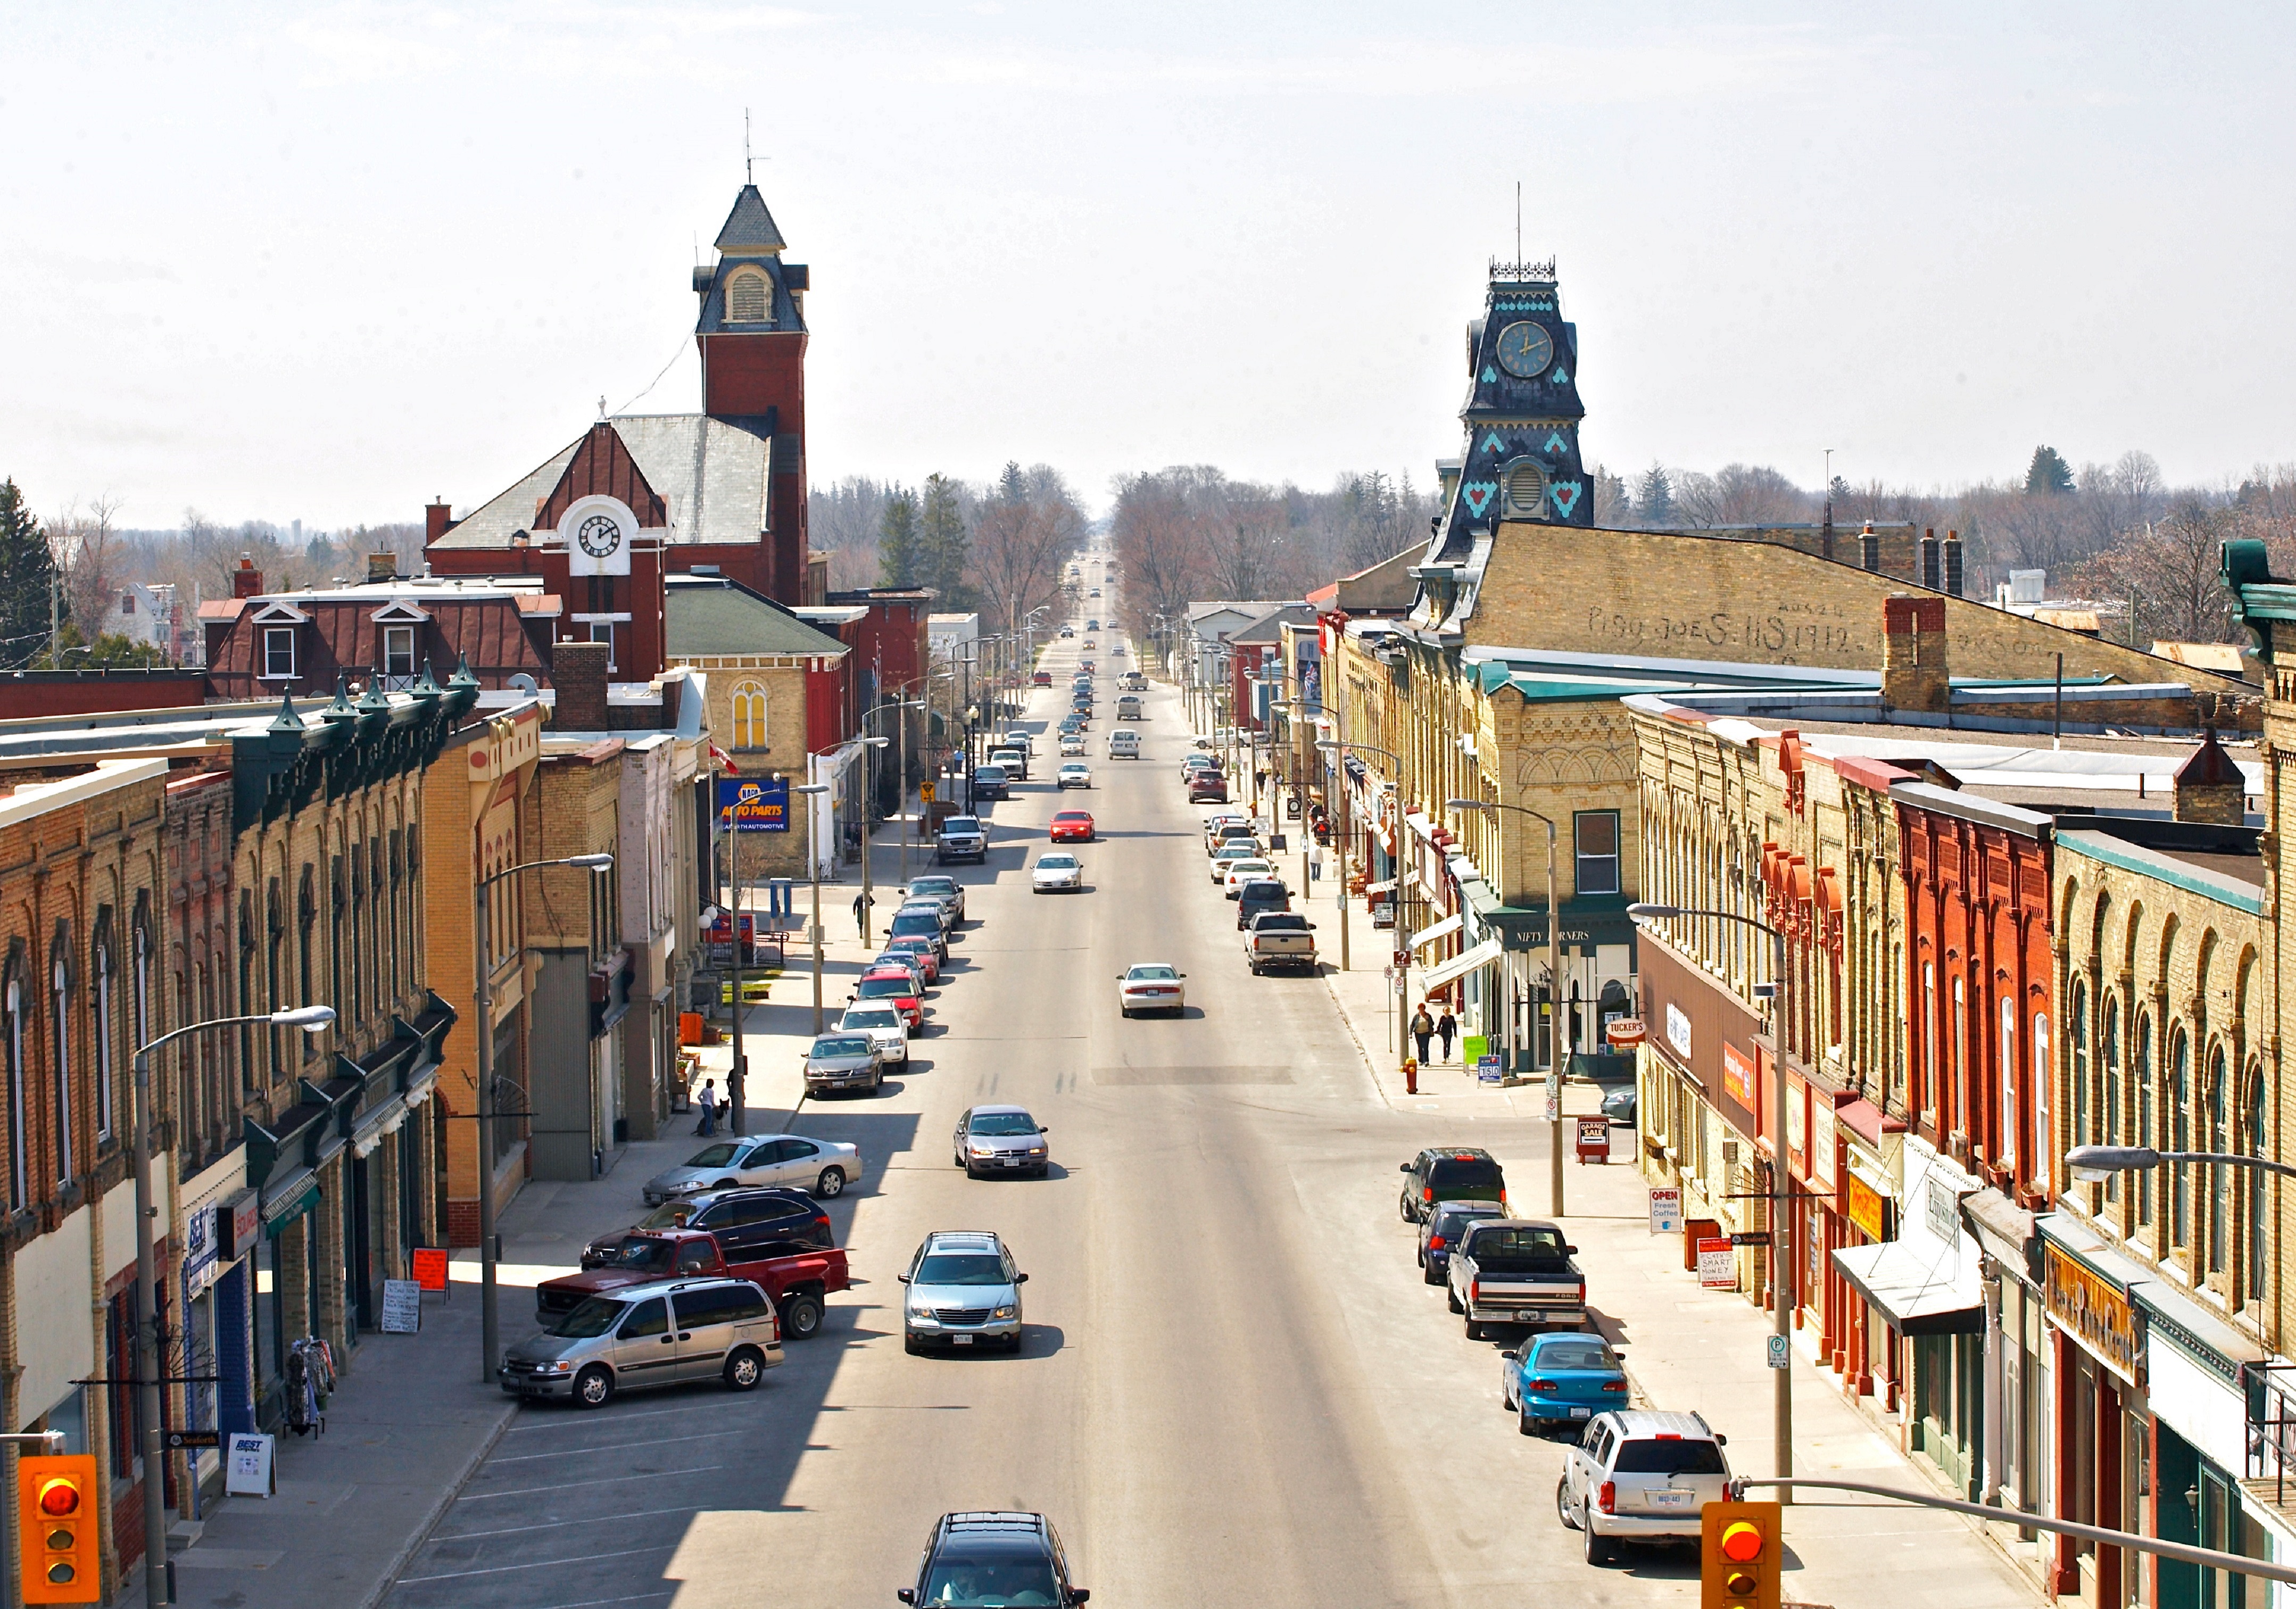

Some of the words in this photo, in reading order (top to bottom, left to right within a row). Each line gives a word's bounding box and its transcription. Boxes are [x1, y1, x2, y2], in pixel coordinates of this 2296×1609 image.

[722, 805, 750, 816] ATO
[751, 805, 782, 816] PARTS
[1516, 932, 1543, 942] NIFTY
[1547, 931, 1589, 941] RNERS
[1611, 1022, 1643, 1032] TUCKER'S
[1652, 1191, 1678, 1200] OPEN
[237, 1440, 263, 1448] BEST
